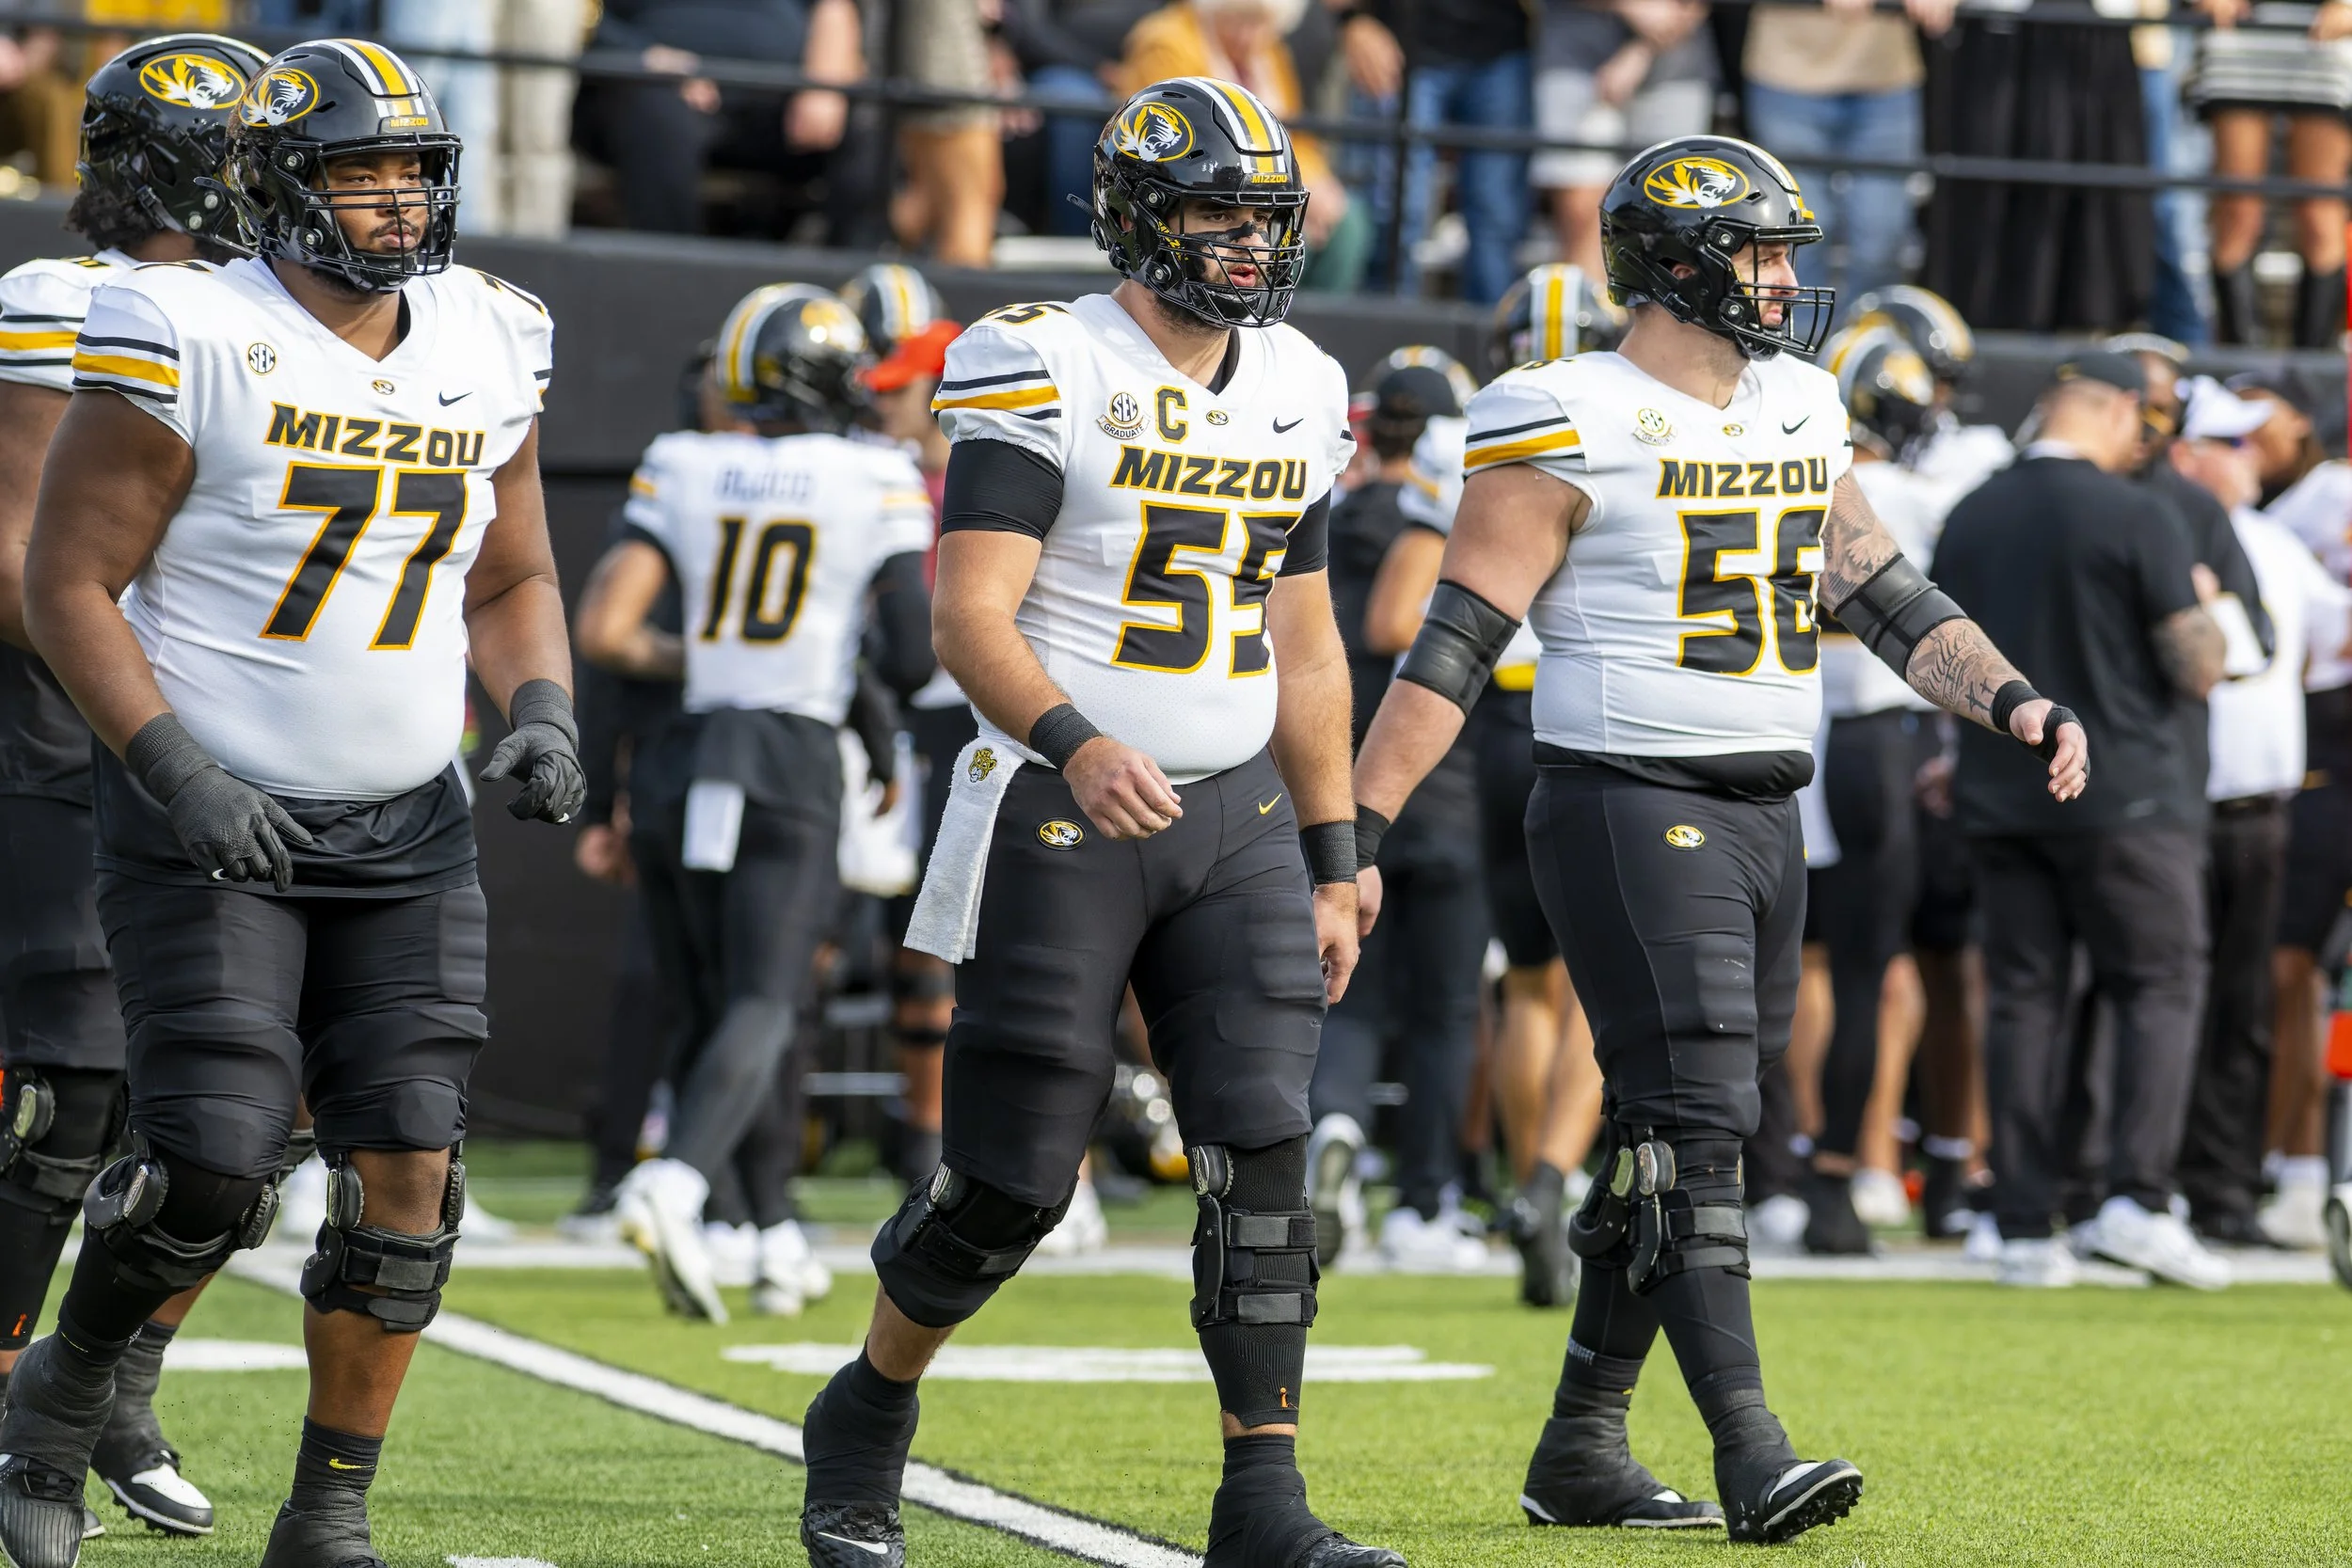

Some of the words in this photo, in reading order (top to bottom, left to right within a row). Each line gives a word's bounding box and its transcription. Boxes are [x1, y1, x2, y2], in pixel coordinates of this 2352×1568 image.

[1250, 174, 1288, 184] MIZZOU
[249, 343, 276, 373] SEC
[263, 401, 485, 467] MIZZOU
[1104, 422, 1145, 438] GRADUATE
[1112, 392, 1138, 422] SEC
[1154, 385, 1189, 445] C
[1108, 444, 1308, 501] MIZZOU
[1656, 456, 1828, 499] MIZZOU
[258, 461, 469, 650] 77
[699, 515, 817, 646] 10
[1109, 500, 1302, 679] 55
[1675, 505, 1828, 677] 56
